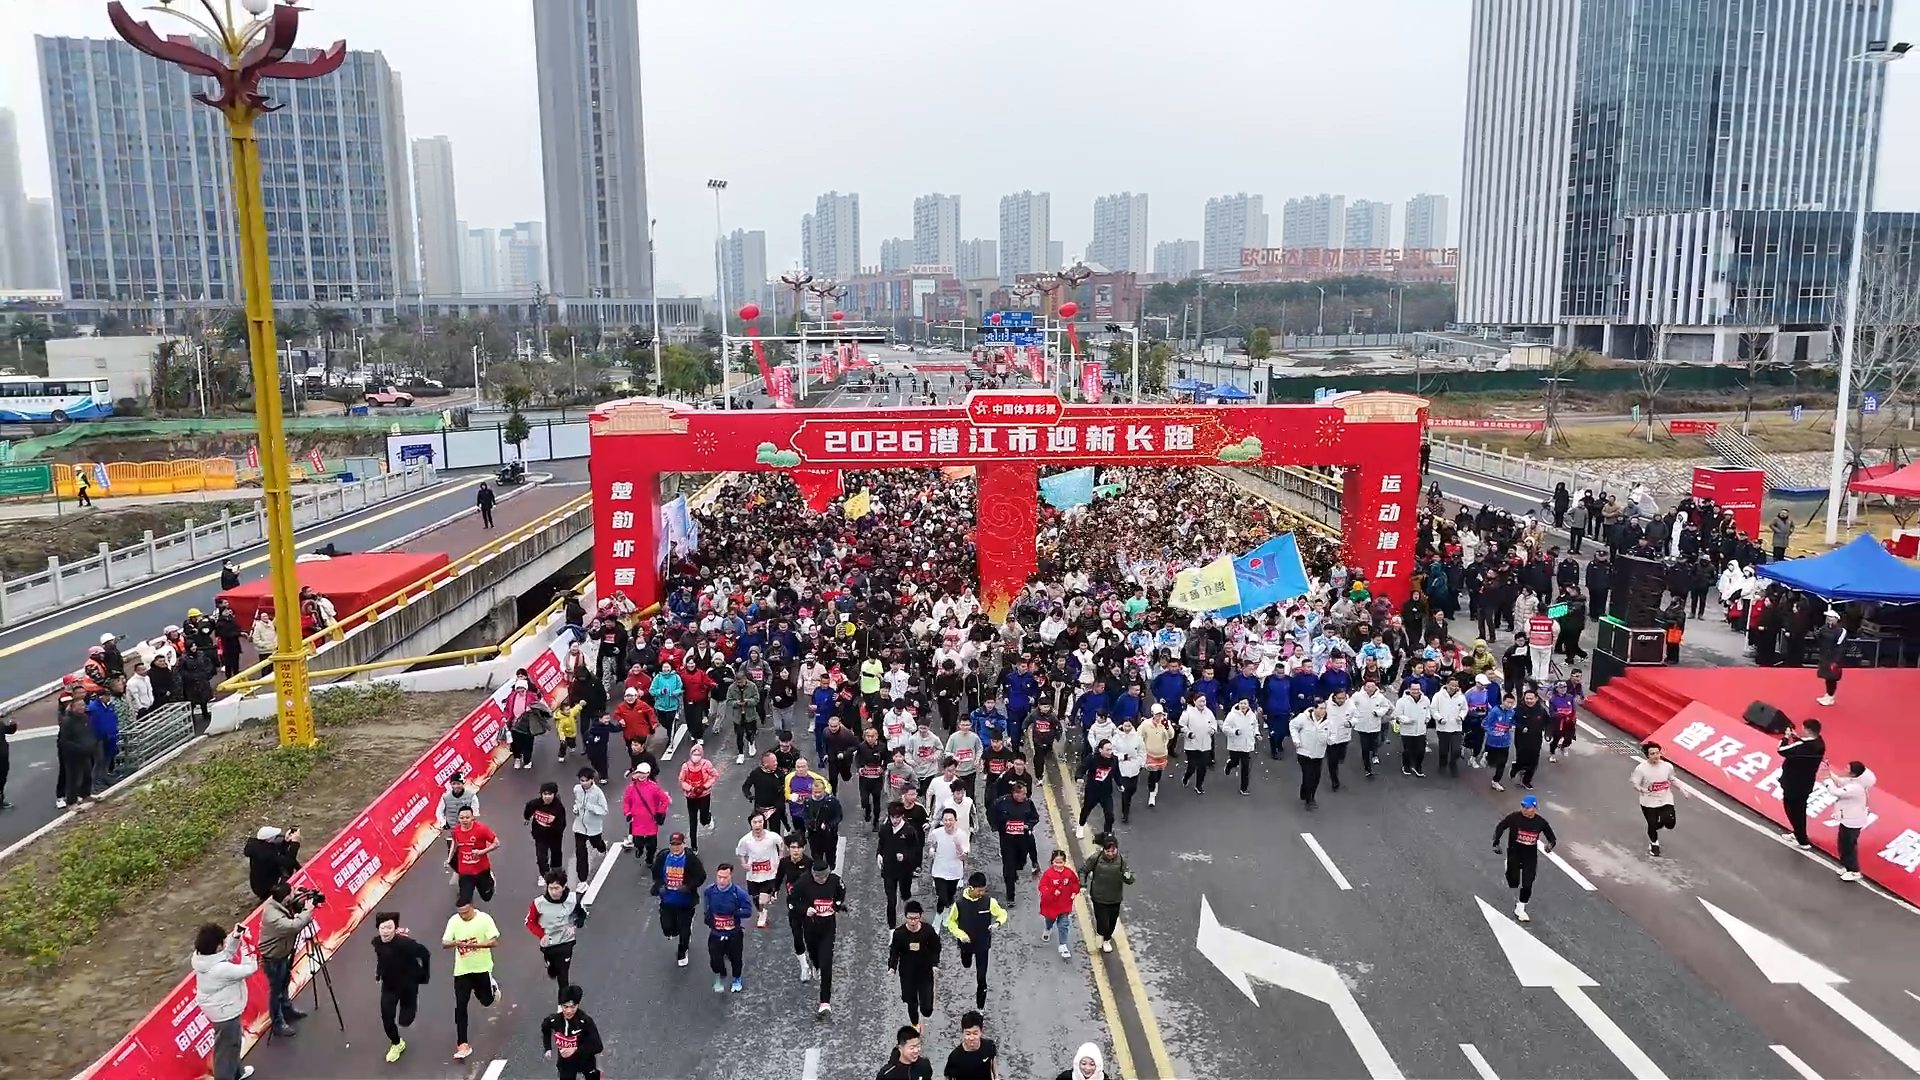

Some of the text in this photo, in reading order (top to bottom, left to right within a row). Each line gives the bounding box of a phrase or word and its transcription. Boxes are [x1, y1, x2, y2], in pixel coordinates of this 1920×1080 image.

[824, 426, 1194, 454] 2026潜江市迎新长跑
[992, 403, 1056, 415] 中国体育彩票
[611, 481, 635, 586] 楚韵虾香
[1376, 474, 1402, 579] 运动潜江
